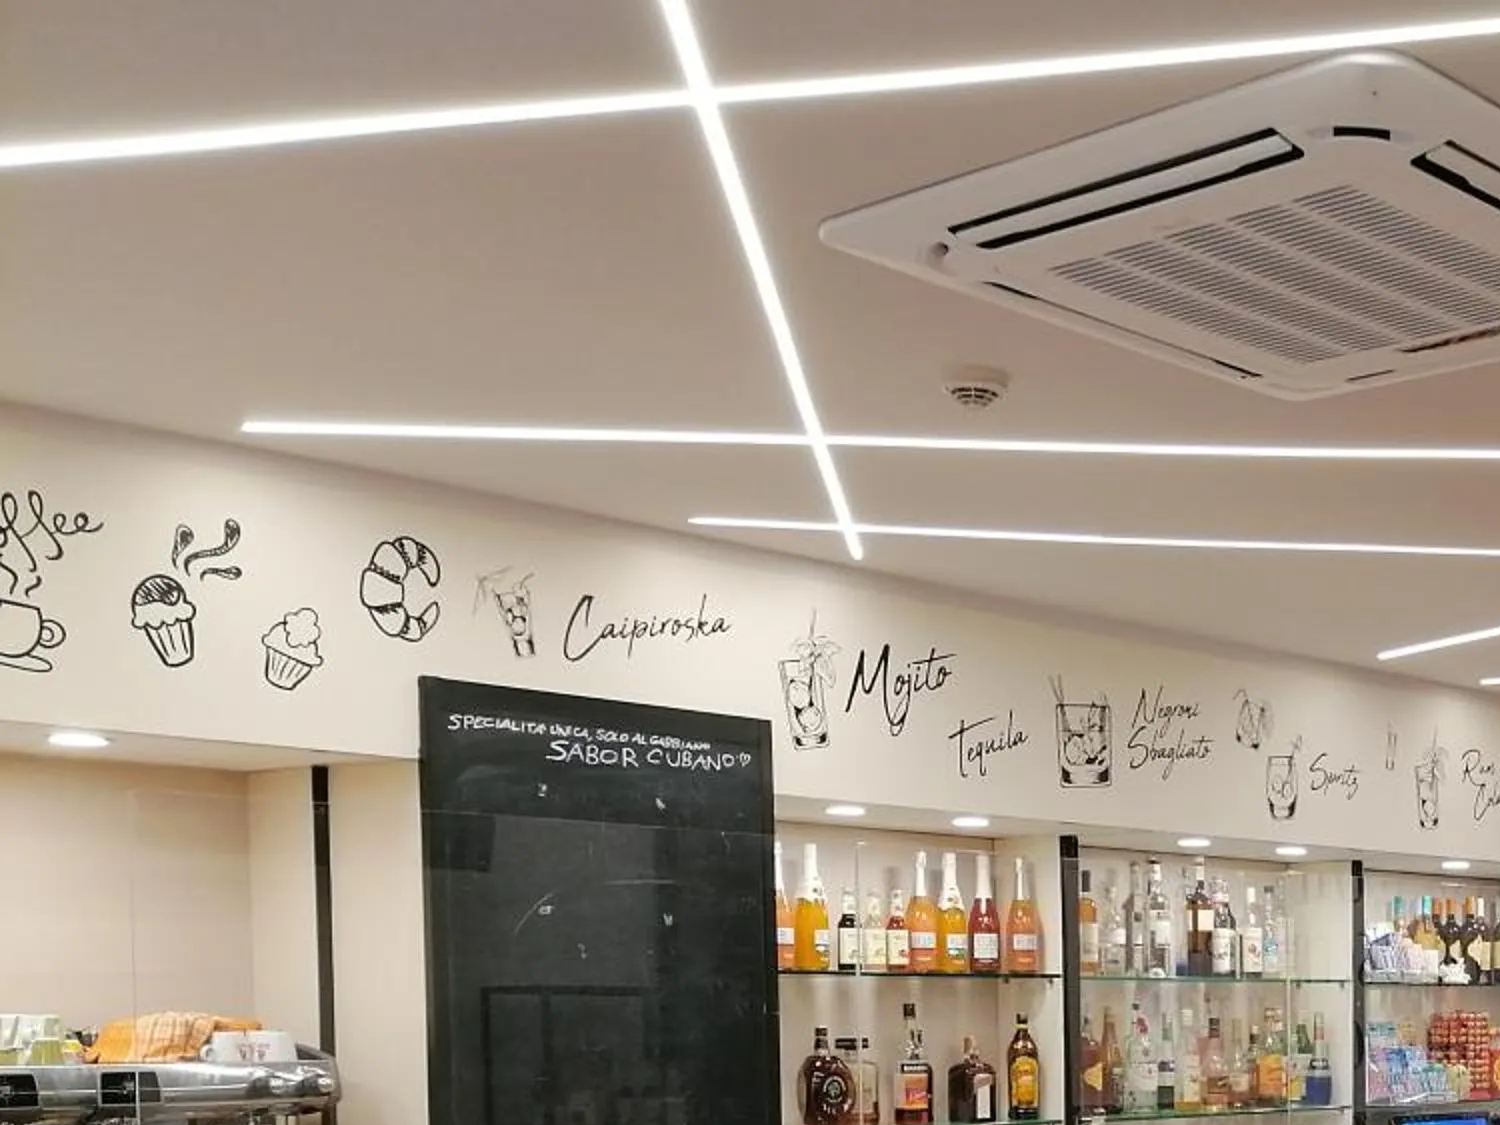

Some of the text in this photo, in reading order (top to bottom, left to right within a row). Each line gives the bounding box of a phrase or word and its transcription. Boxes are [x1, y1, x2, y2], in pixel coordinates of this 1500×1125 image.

[0, 490, 104, 572] offee
[564, 593, 732, 662] Caipiroska
[845, 643, 957, 737] Mojito
[1131, 685, 1200, 738] Negroni
[545, 739, 735, 771] SABOR CUBANO
[596, 728, 629, 743] SOLO
[631, 733, 647, 745] AL
[948, 709, 1029, 778] Tequila
[1127, 725, 1215, 781] Sbagliato
